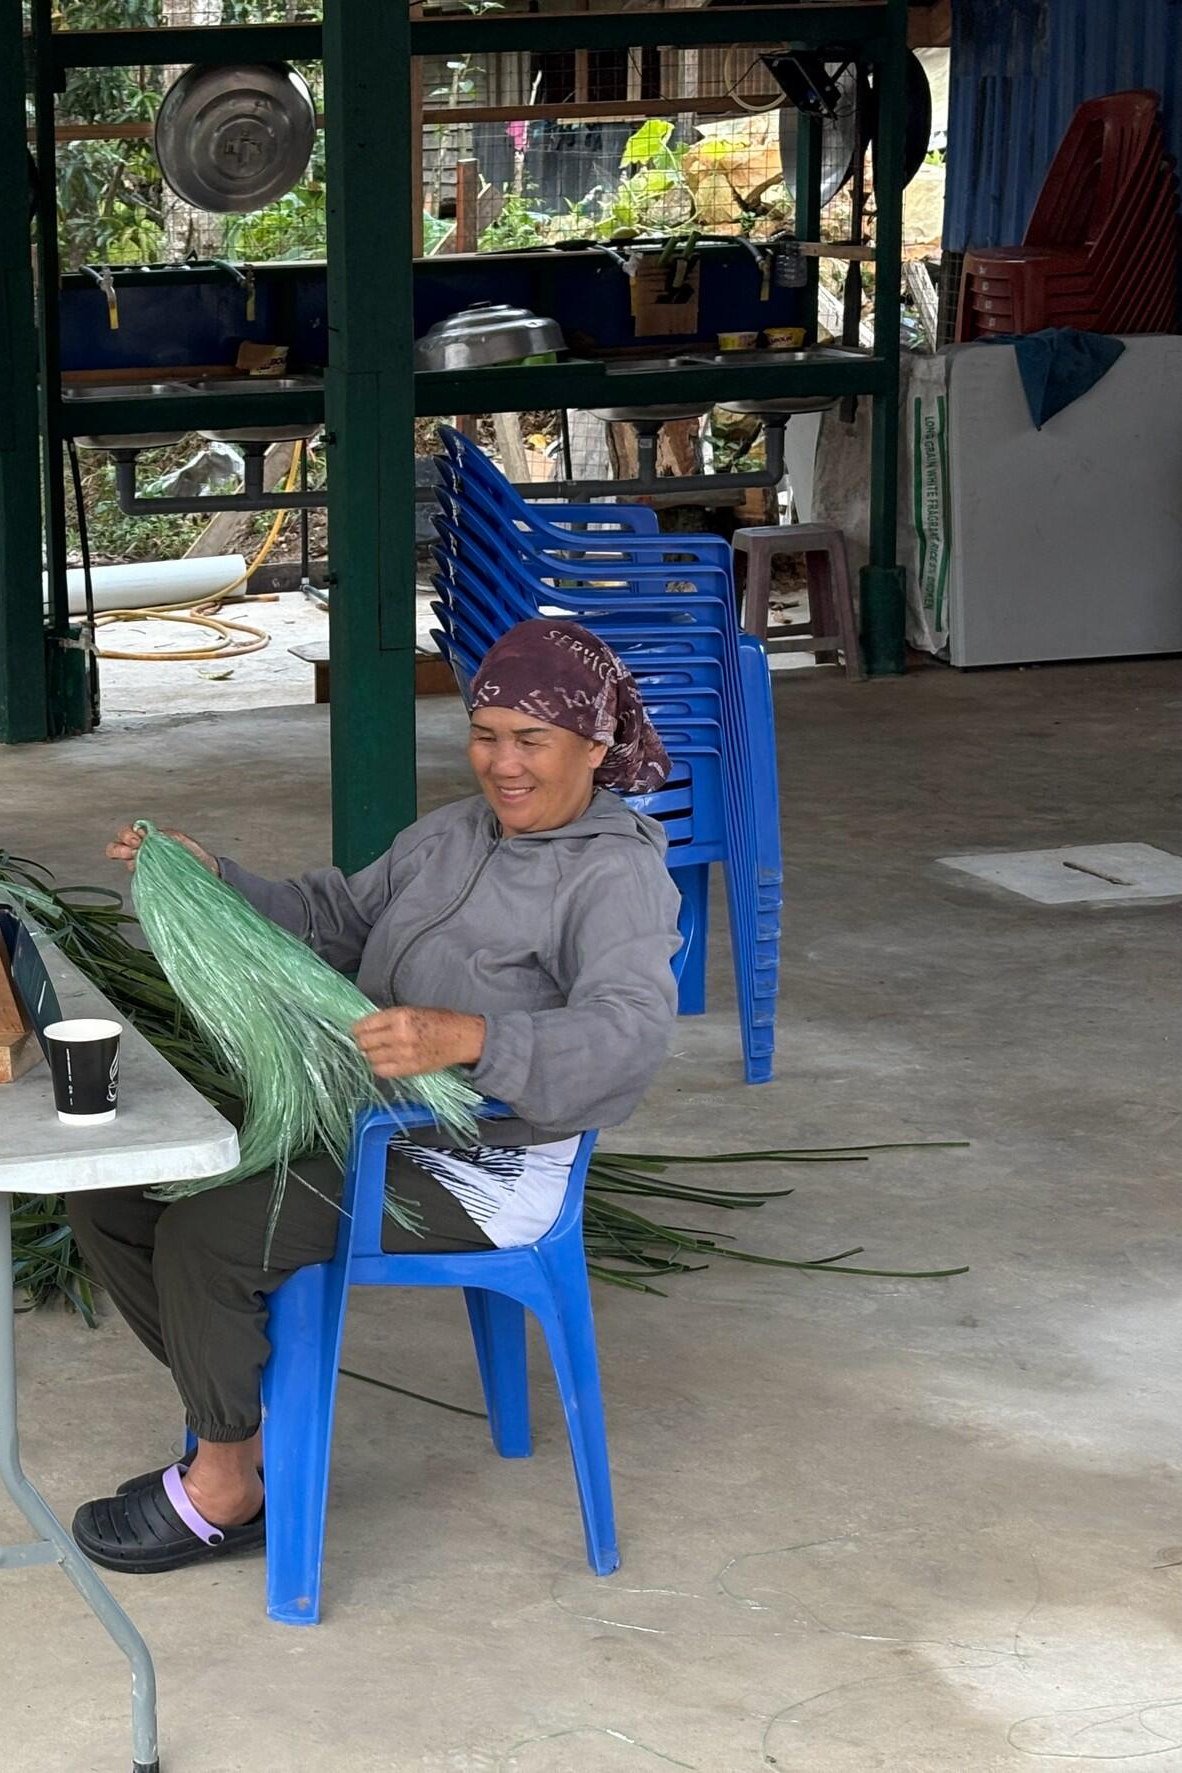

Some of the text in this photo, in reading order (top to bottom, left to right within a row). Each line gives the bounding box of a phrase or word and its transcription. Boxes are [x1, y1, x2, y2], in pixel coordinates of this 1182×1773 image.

[925, 415, 936, 440] LONG
[924, 440, 937, 468] GRAIN
[926, 469, 939, 497] WHITE
[926, 498, 940, 542] FRAGRANT
[929, 543, 939, 562] RICE
